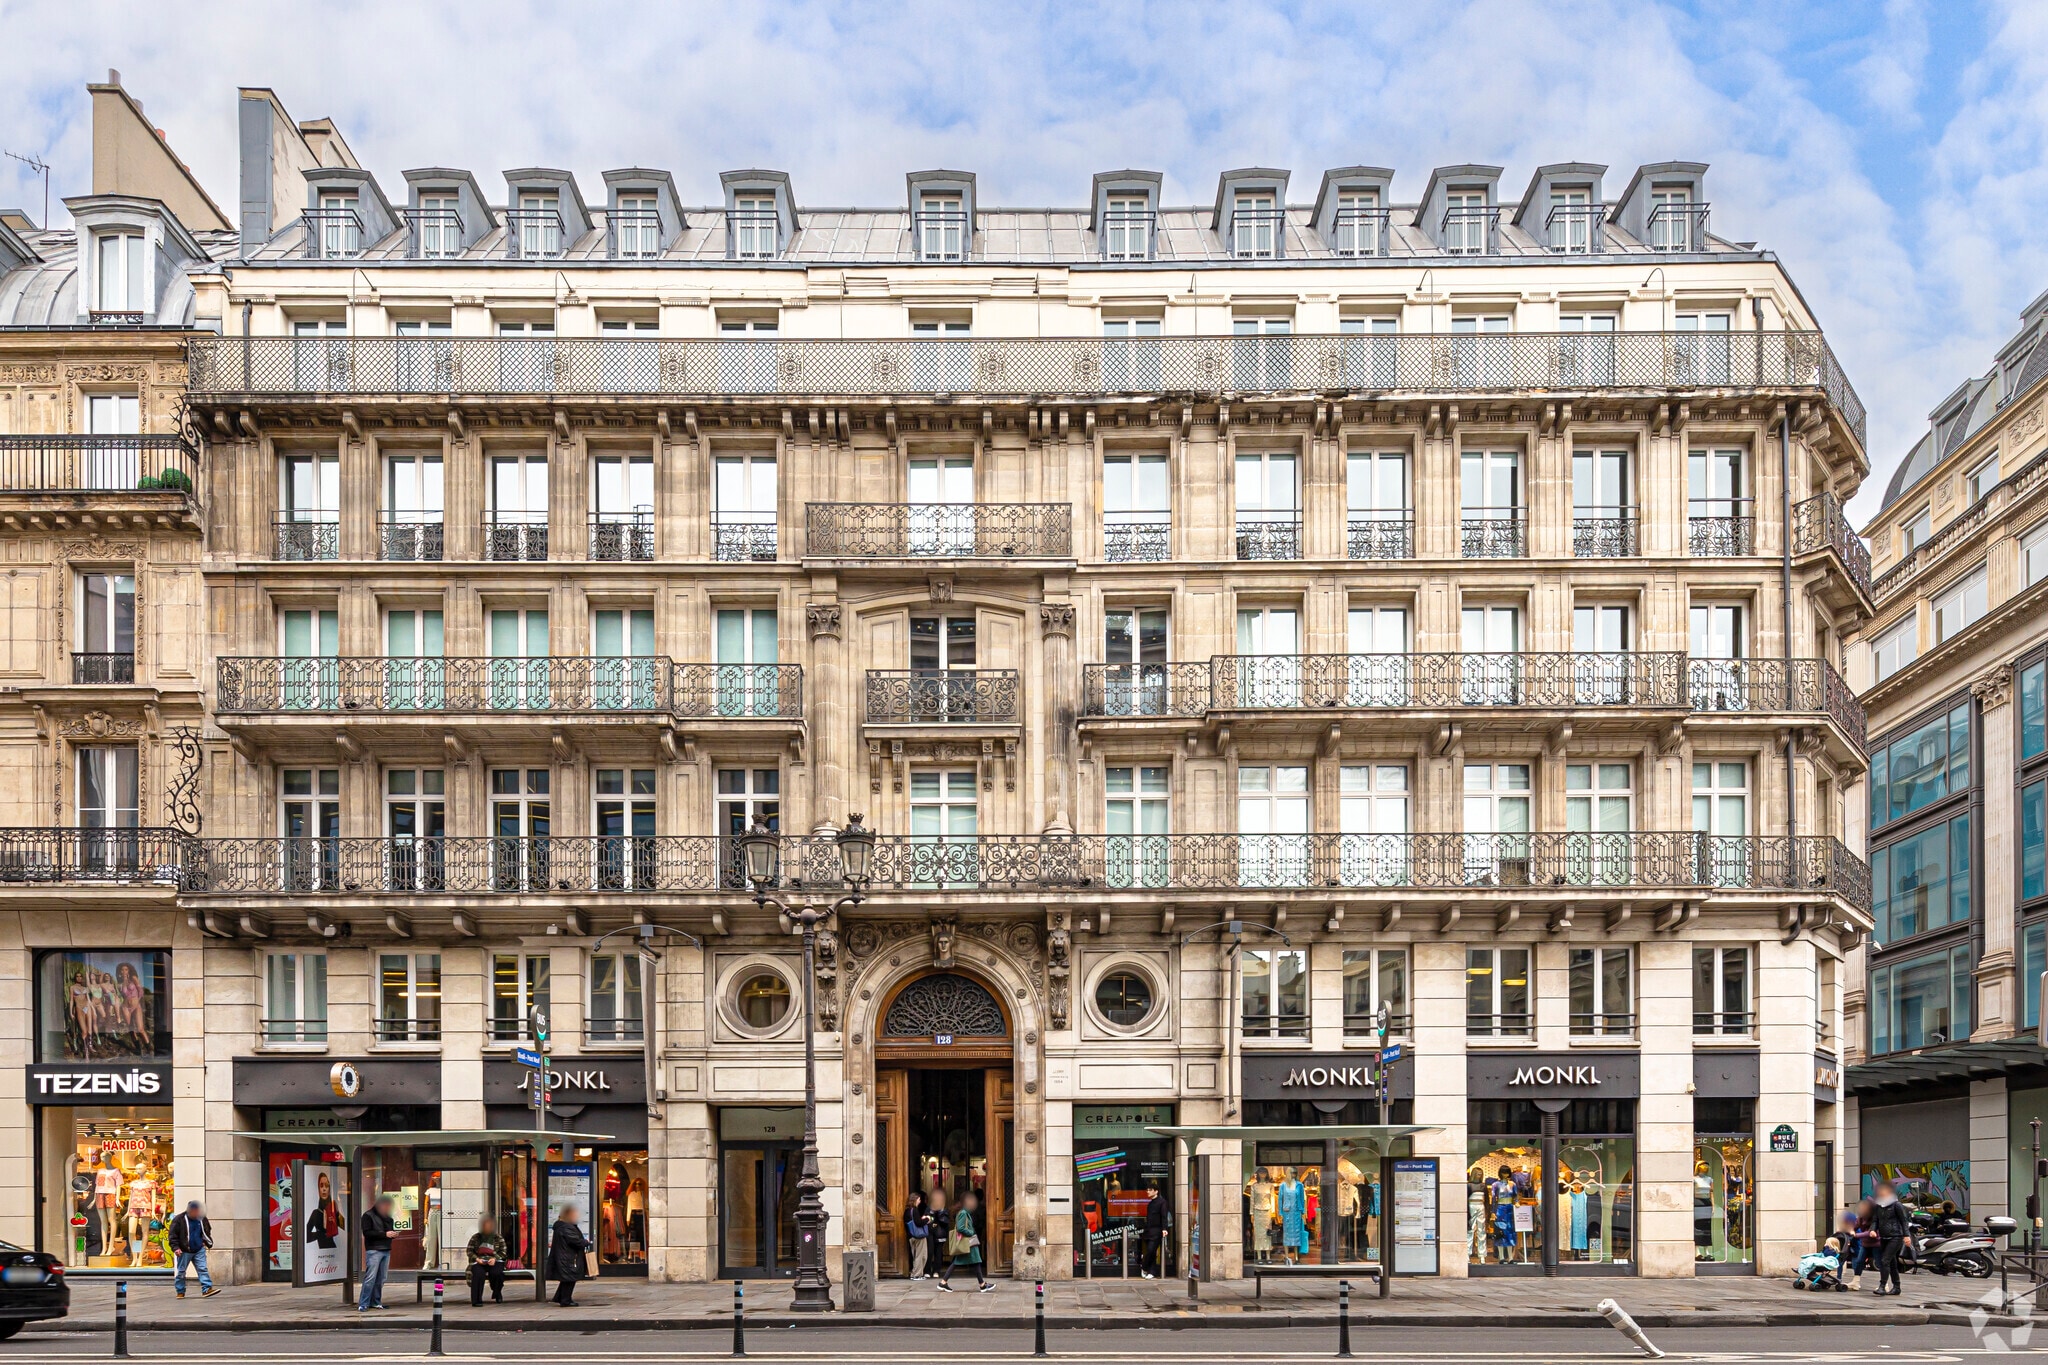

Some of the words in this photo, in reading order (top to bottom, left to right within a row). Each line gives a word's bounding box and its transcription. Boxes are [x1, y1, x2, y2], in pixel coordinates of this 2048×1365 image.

[536, 1012, 546, 1026] BUS
[1378, 1008, 1386, 1022] BUS
[937, 1036, 951, 1044] 128
[1282, 1067, 1375, 1086] MONKI
[1509, 1066, 1601, 1084] MONKI
[102, 1140, 146, 1151] HARIBO
[395, 1217, 411, 1228] eal
[1091, 1232, 1104, 1240] MA
[1105, 1224, 1137, 1236] PASSON,
[314, 1262, 338, 1274] Cartier
